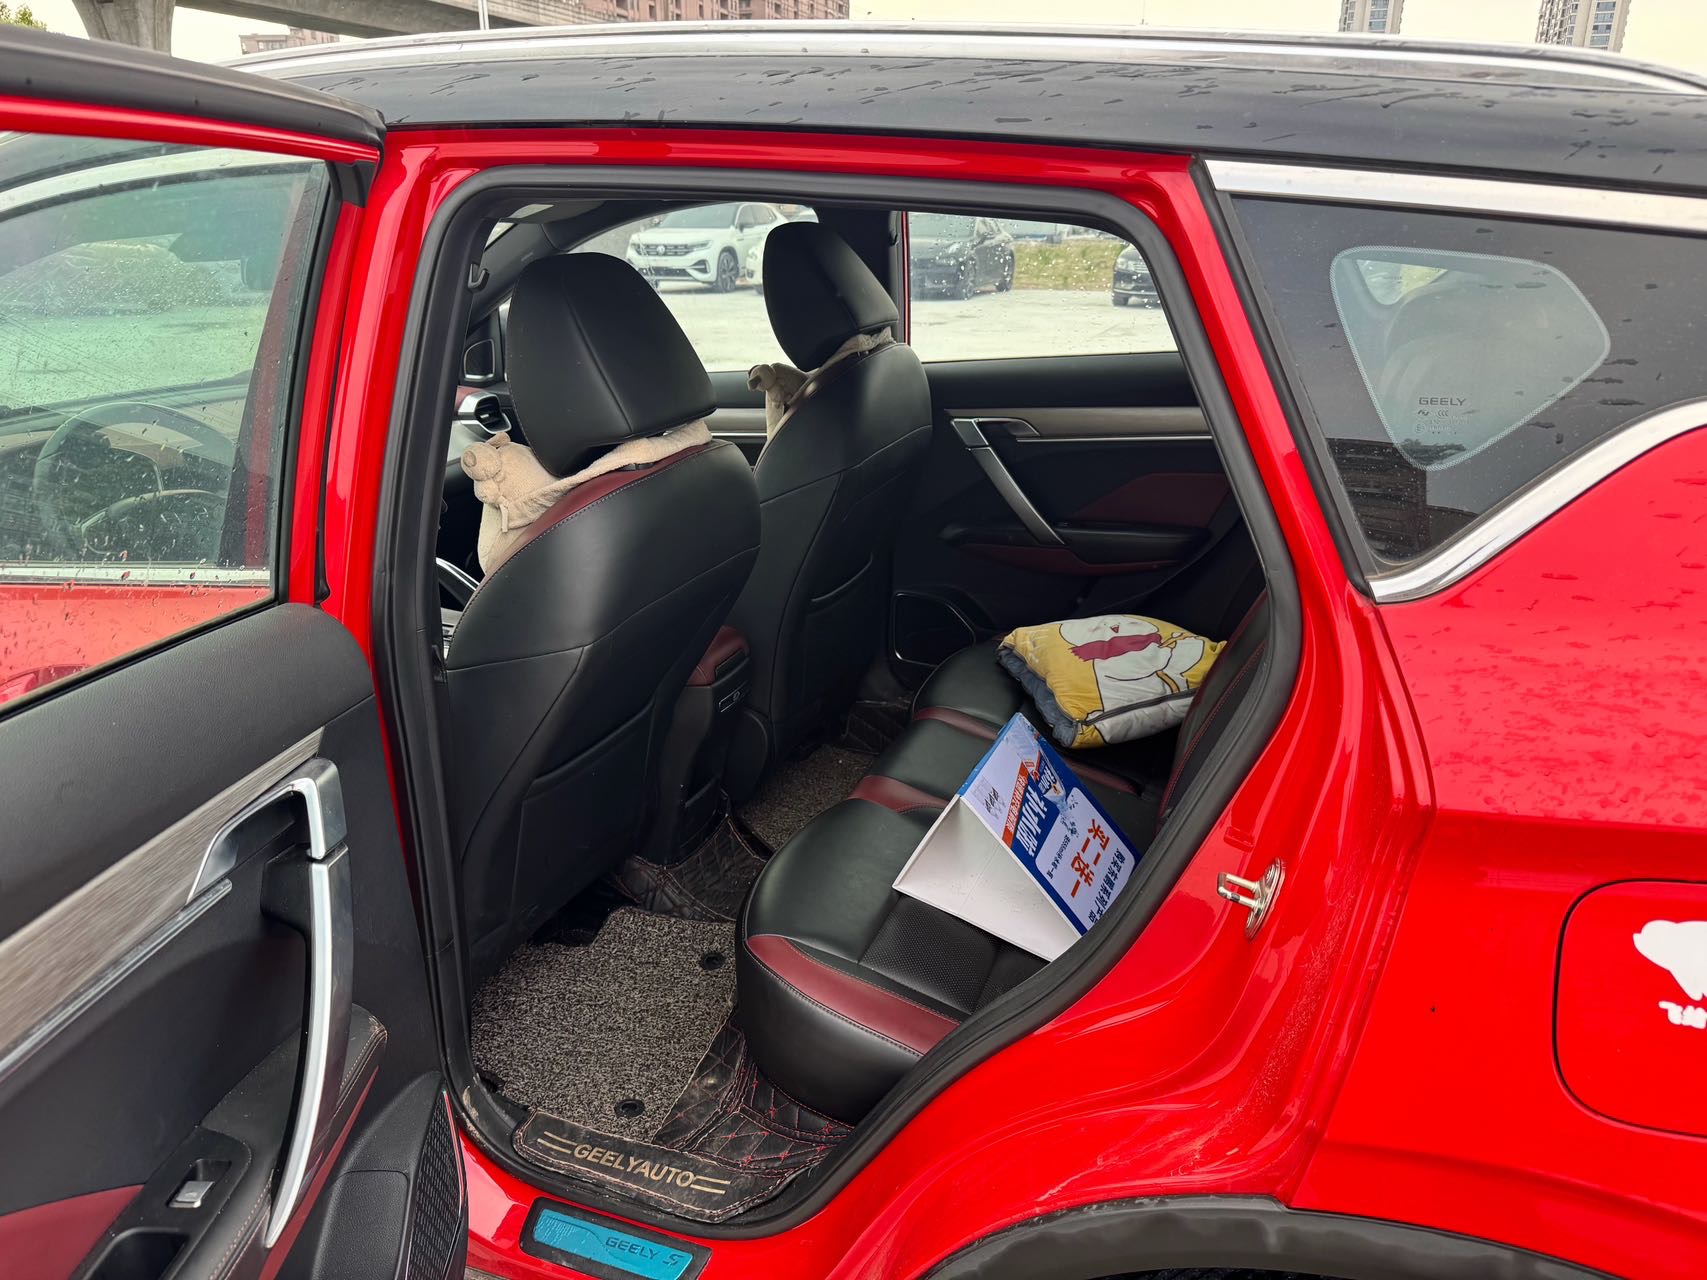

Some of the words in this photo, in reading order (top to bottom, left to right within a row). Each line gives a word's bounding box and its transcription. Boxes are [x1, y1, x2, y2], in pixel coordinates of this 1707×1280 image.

[1418, 397, 1466, 406] GEELY
[1016, 784, 1047, 856] 补水啦
[1070, 818, 1110, 898] 买二送一
[1087, 848, 1125, 924] 购买东鹏系列产品
[573, 1144, 694, 1187] GEELYAUTO
[605, 1236, 659, 1260] GEELY
